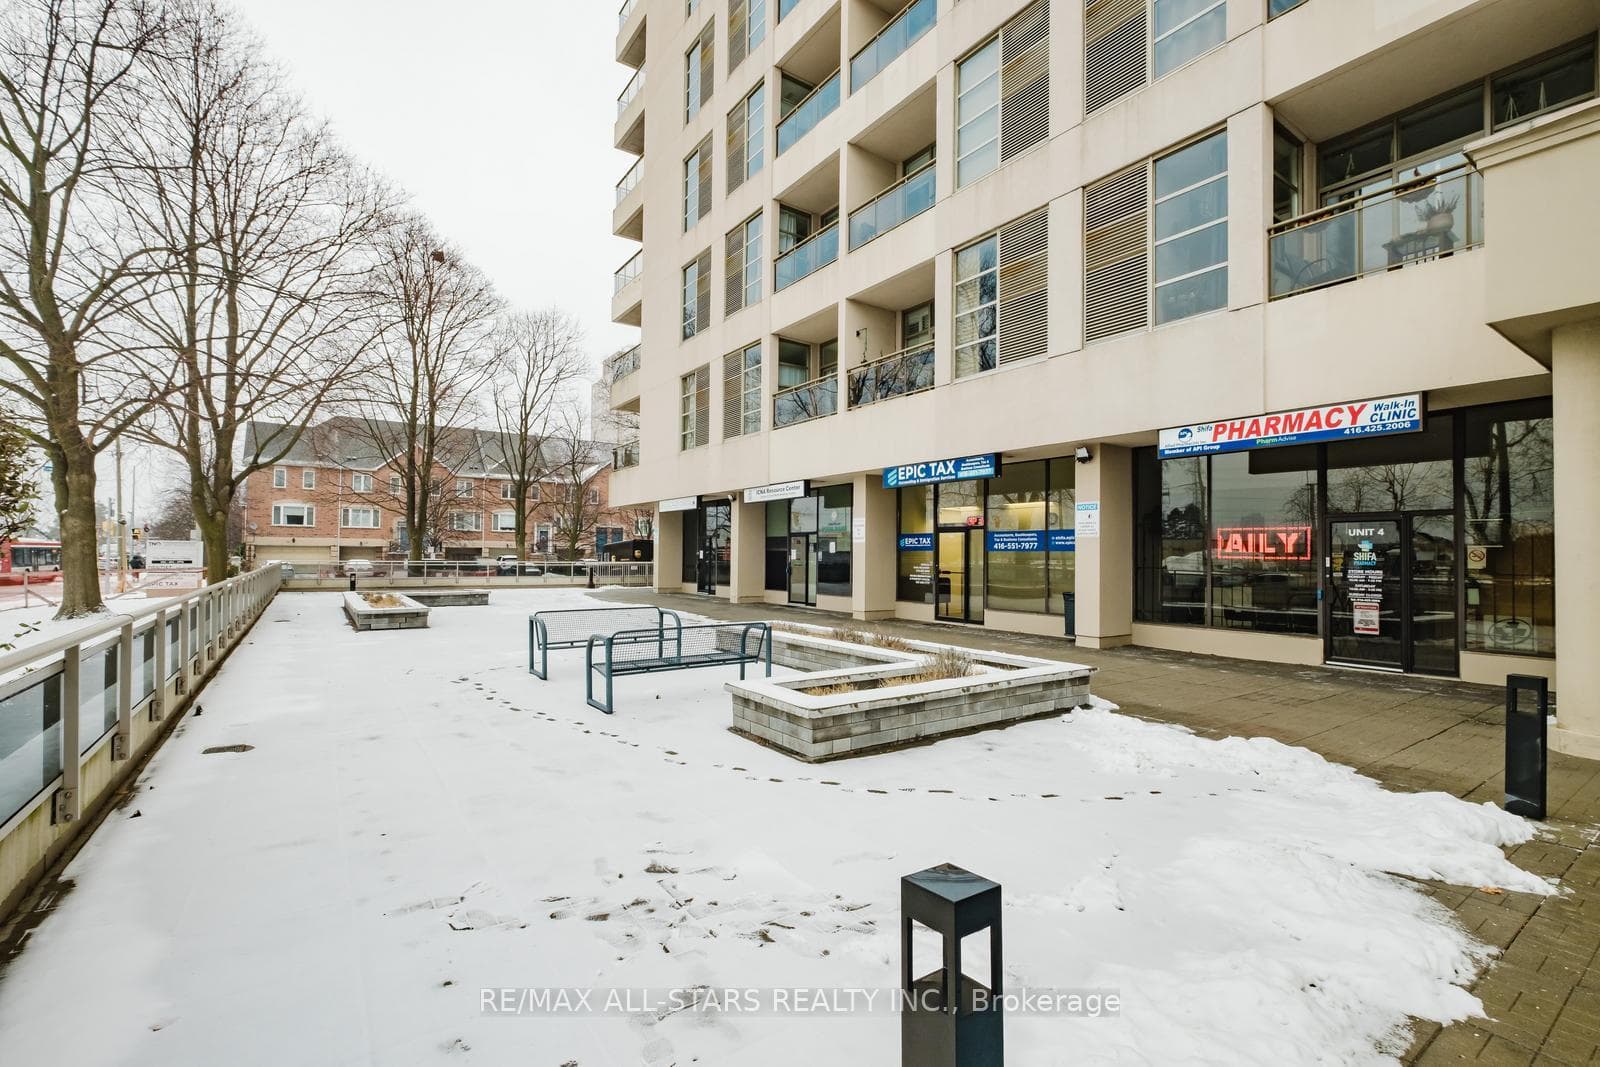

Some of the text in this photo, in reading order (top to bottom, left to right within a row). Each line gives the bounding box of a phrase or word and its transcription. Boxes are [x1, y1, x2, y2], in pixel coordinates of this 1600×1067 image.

[1373, 399, 1415, 412] Walk-In
[1370, 408, 1417, 423] CLINIC
[1212, 403, 1368, 443] PHARMACY
[1343, 421, 1411, 435] 416.425.2006
[1196, 425, 1213, 433] Shifa
[898, 464, 926, 480] EPIC
[929, 460, 956, 477] TAX
[1077, 503, 1098, 511] NOTICE
[1348, 528, 1385, 536] UNIT 4
[905, 537, 931, 545] EPIC TAX
[993, 542, 1039, 550] 416-551-7977
[1353, 551, 1377, 561] SHIFA
